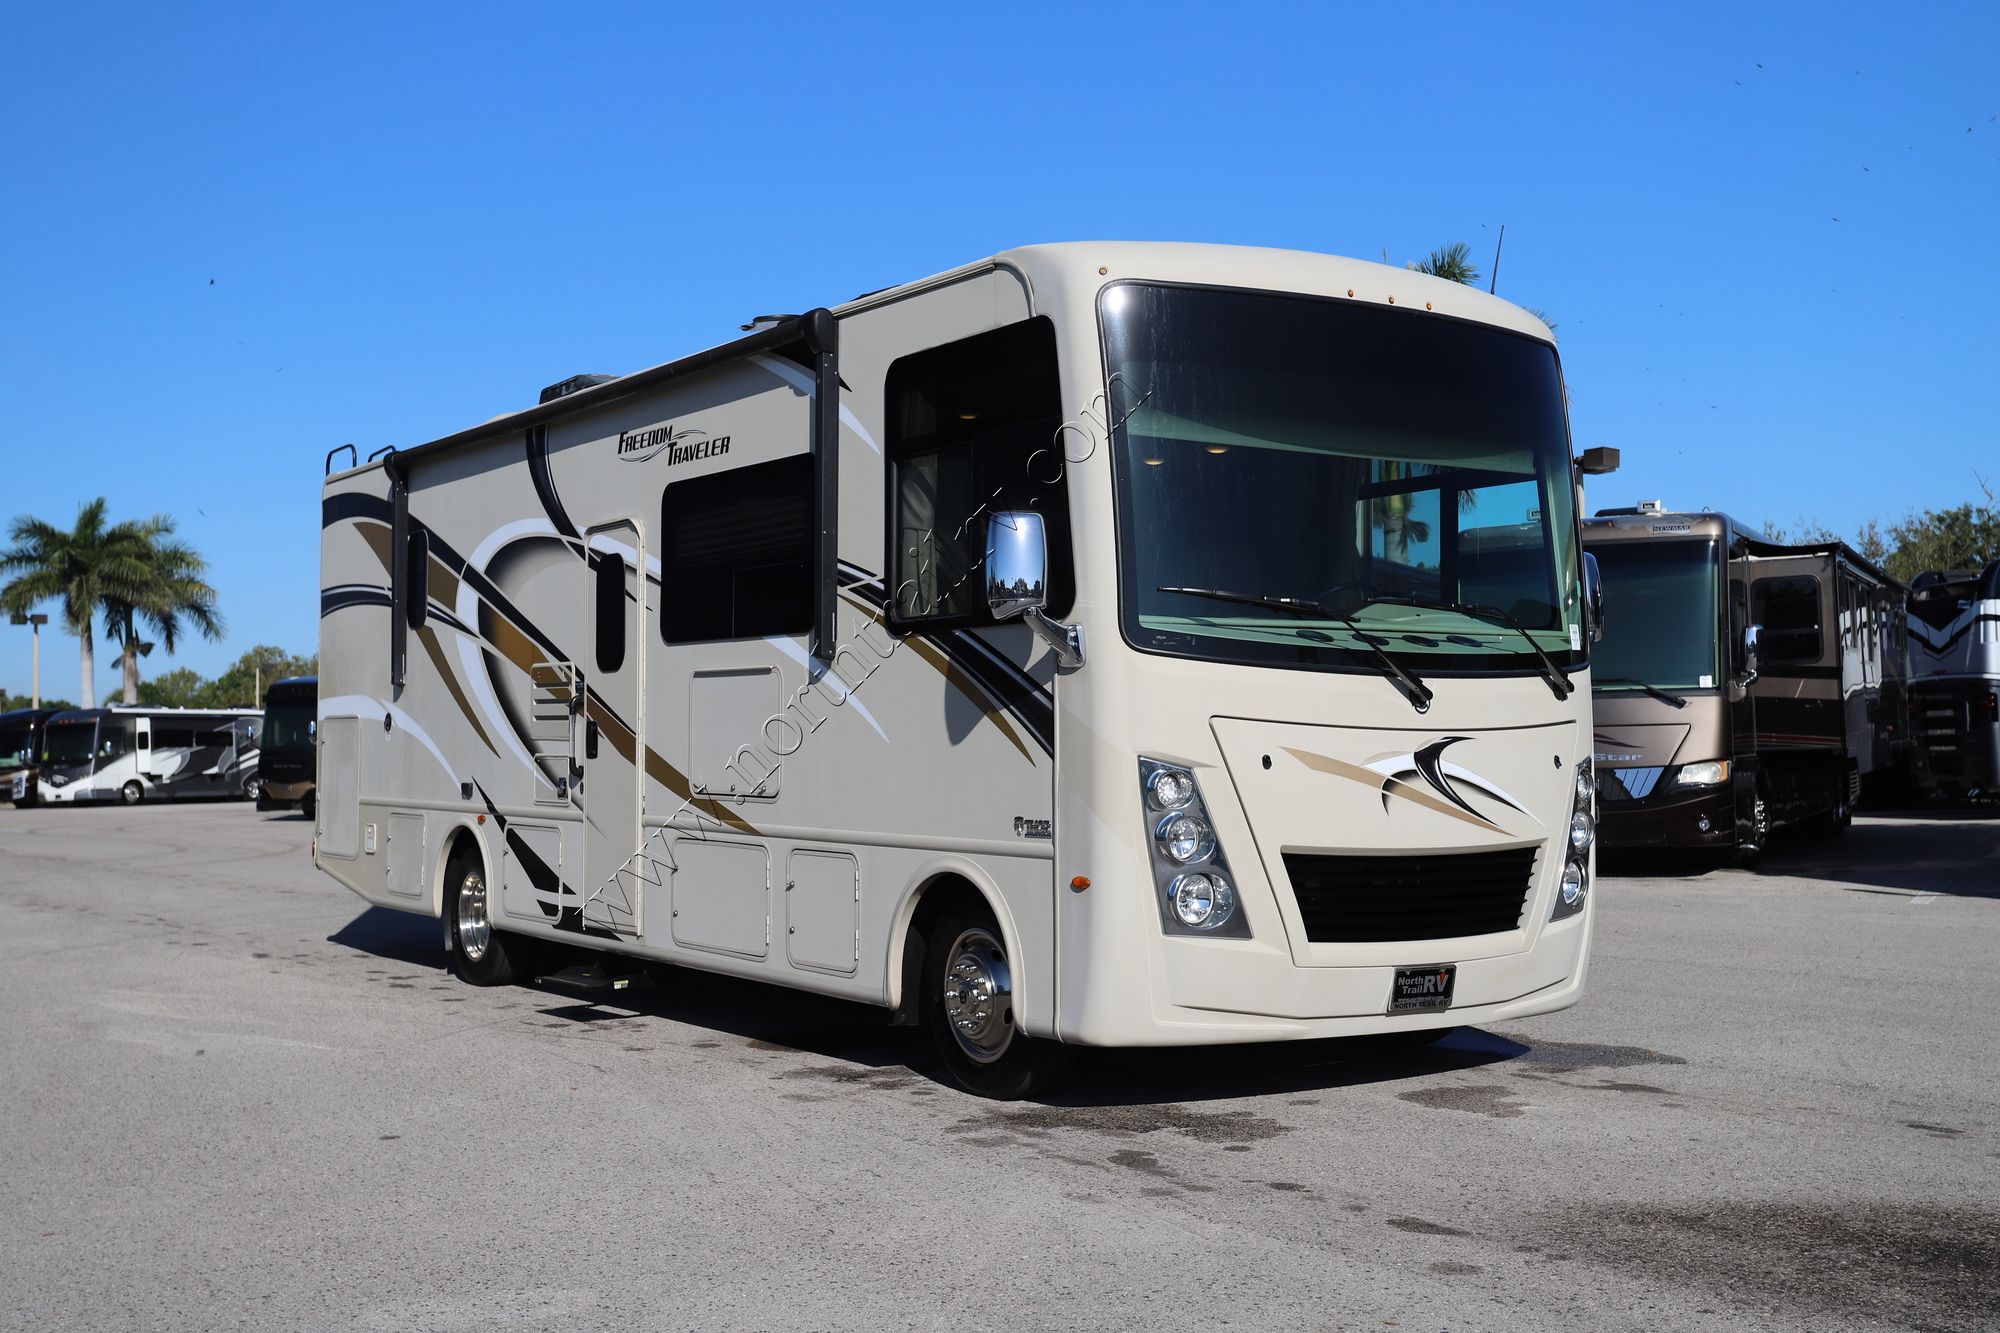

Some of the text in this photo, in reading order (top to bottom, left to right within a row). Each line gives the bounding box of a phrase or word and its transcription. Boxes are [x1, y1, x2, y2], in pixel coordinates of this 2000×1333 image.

[617, 425, 673, 455] FREEDOM
[667, 436, 731, 466] TRAVELER
[1398, 976, 1424, 986] North
[1402, 985, 1423, 994] Trail
[1423, 974, 1449, 993] RV
